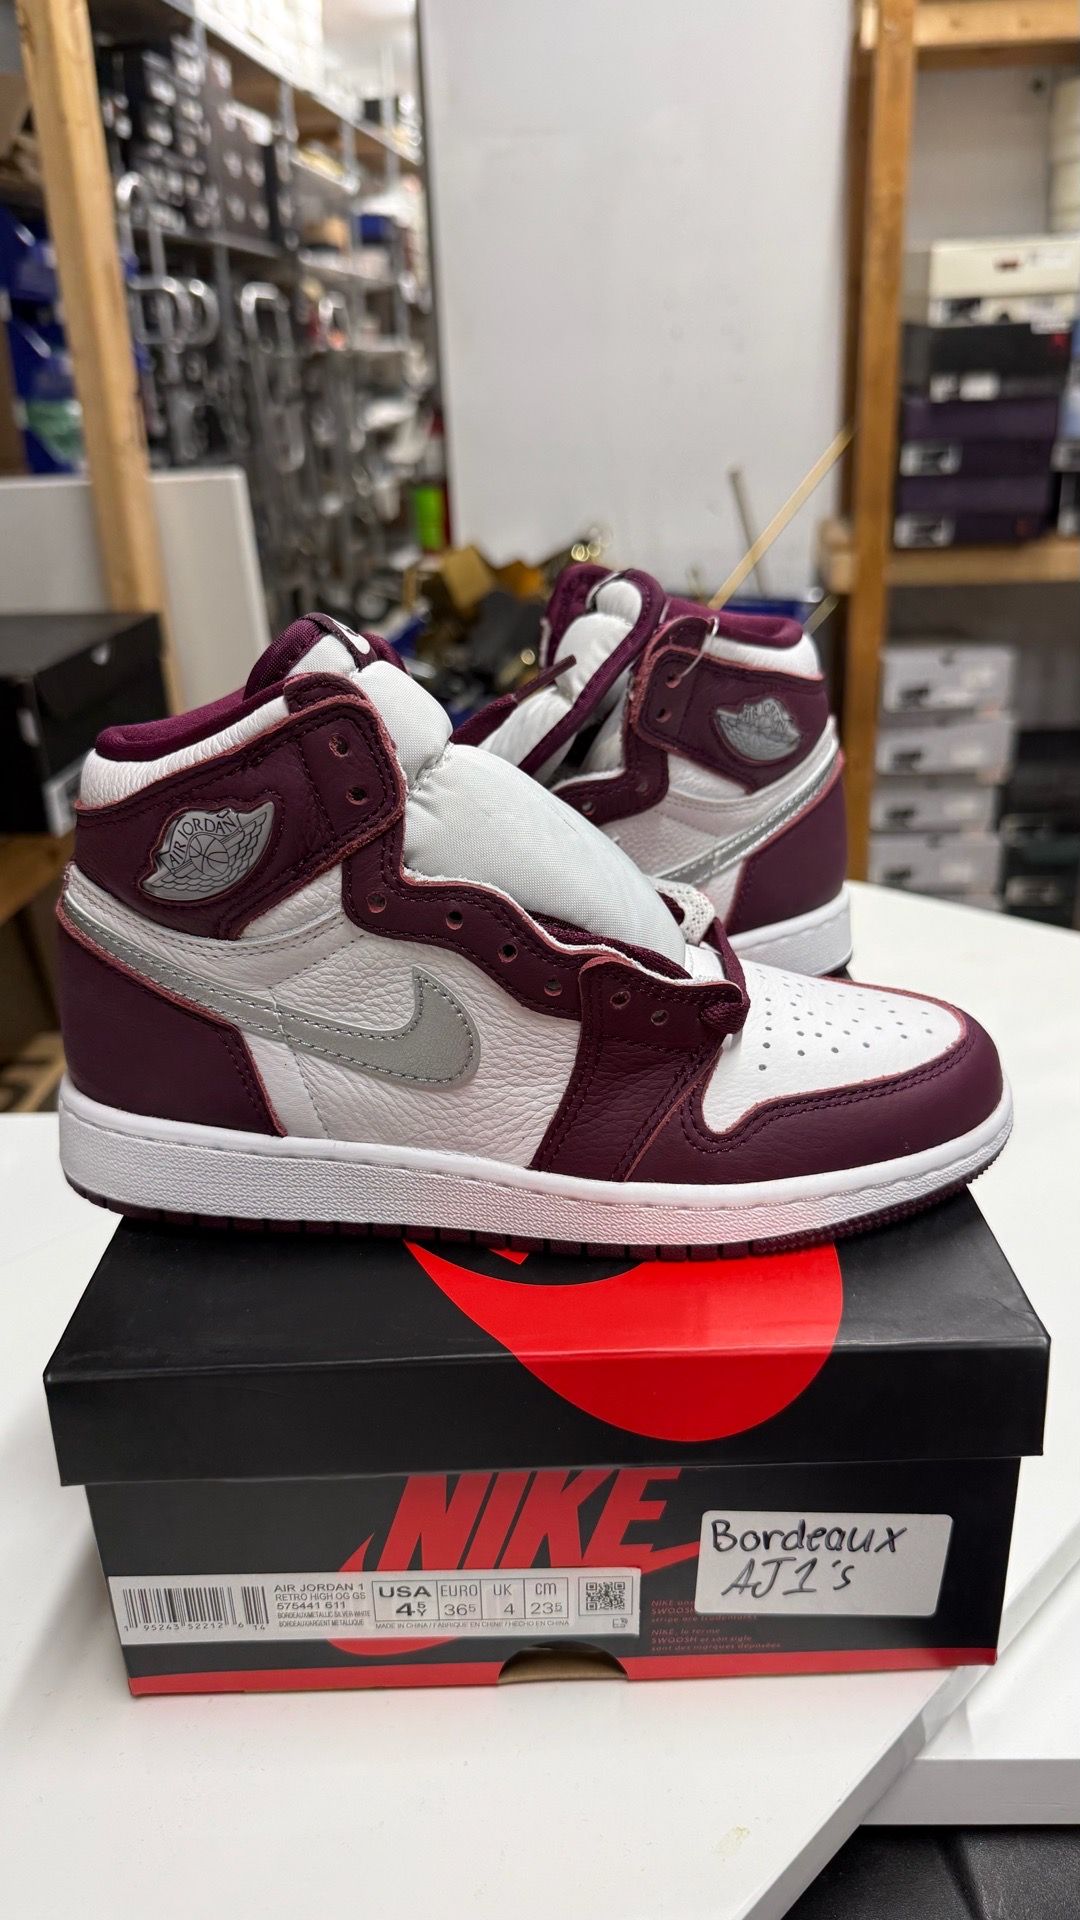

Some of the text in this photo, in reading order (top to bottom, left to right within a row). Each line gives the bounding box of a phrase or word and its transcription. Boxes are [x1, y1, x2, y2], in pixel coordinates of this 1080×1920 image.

[169, 815, 237, 867] AIR JORDAN
[376, 1467, 682, 1571] NIKE
[711, 1519, 907, 1553] Bordeaux
[274, 1583, 296, 1592] AIR
[300, 1583, 354, 1592] JORDAN
[378, 1585, 432, 1598] USA
[440, 1584, 478, 1597] EURO
[493, 1583, 512, 1596] UK
[275, 1591, 366, 1601] RETRO HIGH OG GS
[276, 1601, 346, 1610] 575441 611
[503, 1602, 515, 1615] 4
[188, 1622, 224, 1630] 52212
[651, 1636, 697, 1644] SWOOSH
